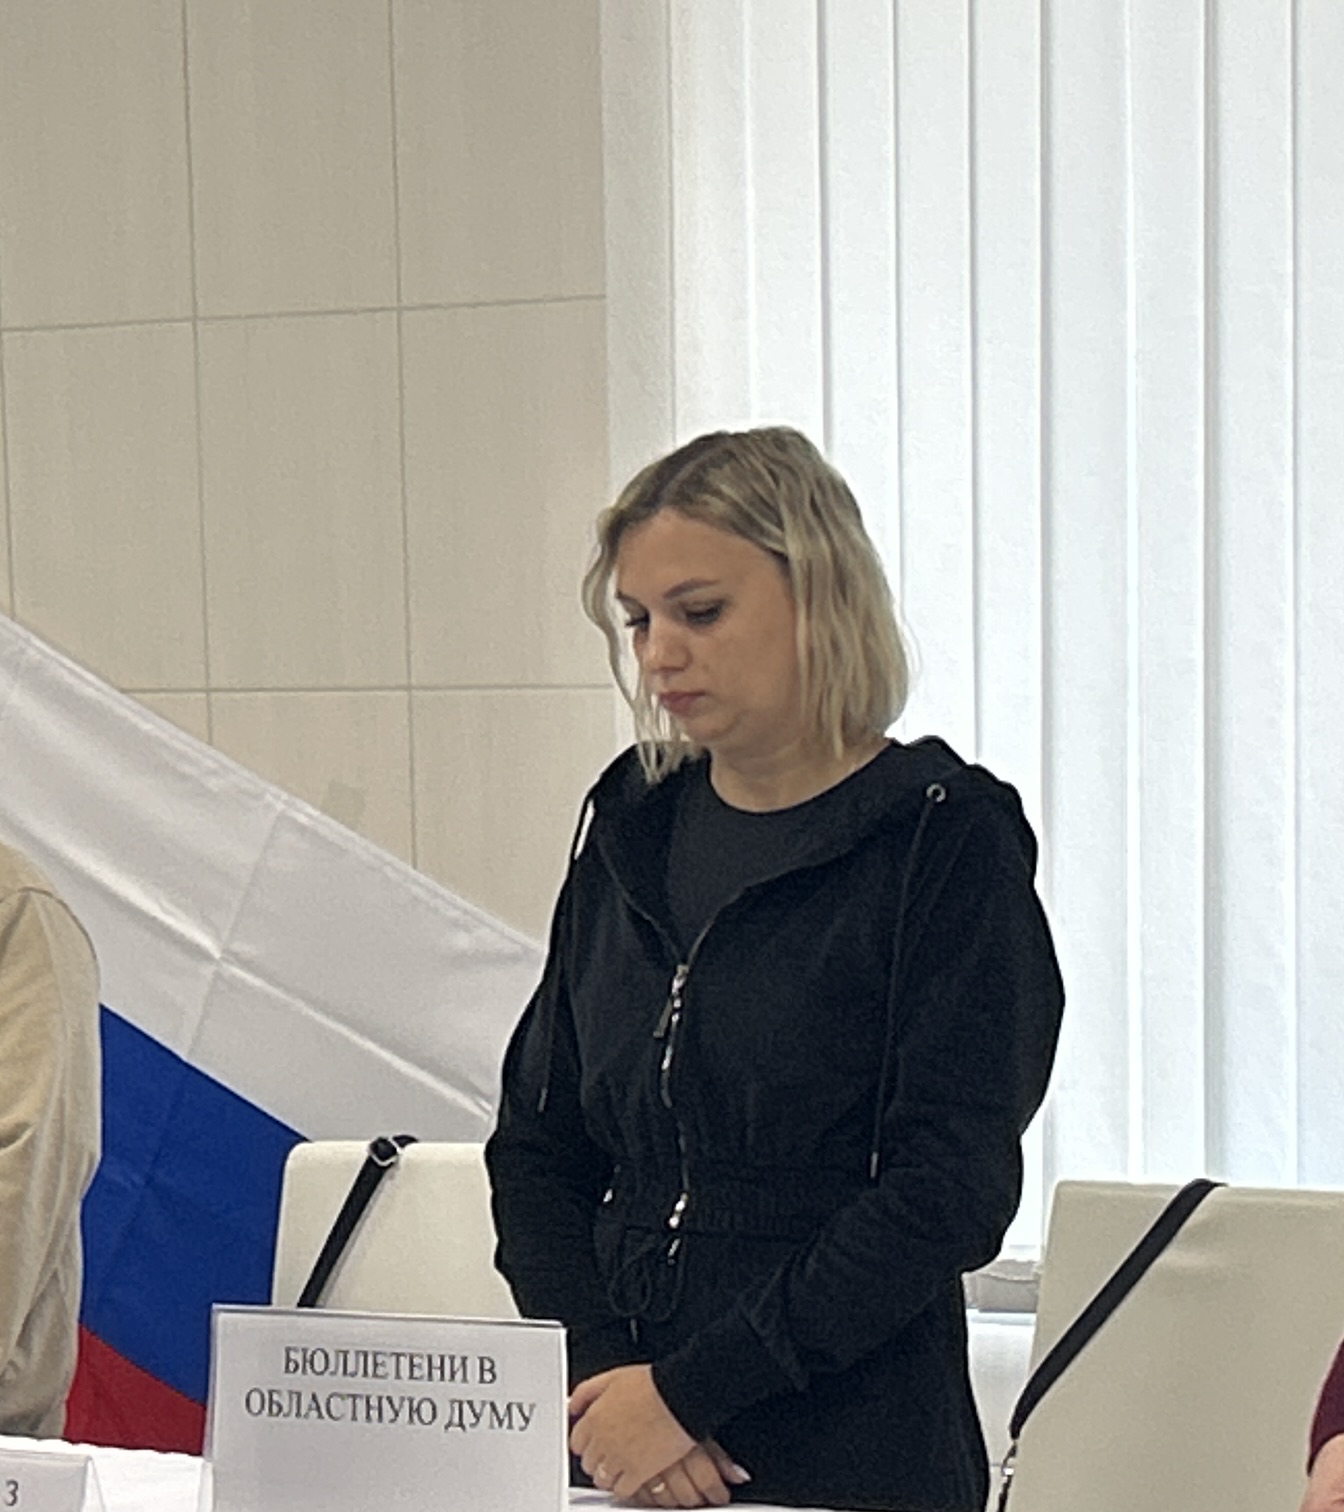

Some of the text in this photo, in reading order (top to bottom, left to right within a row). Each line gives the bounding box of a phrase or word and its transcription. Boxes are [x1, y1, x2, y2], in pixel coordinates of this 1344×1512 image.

[283, 1346, 498, 1385] БЮЛЛЕТЕНИ В
[244, 1387, 537, 1432] ОБЛАСТНУЮ ДУМУ
